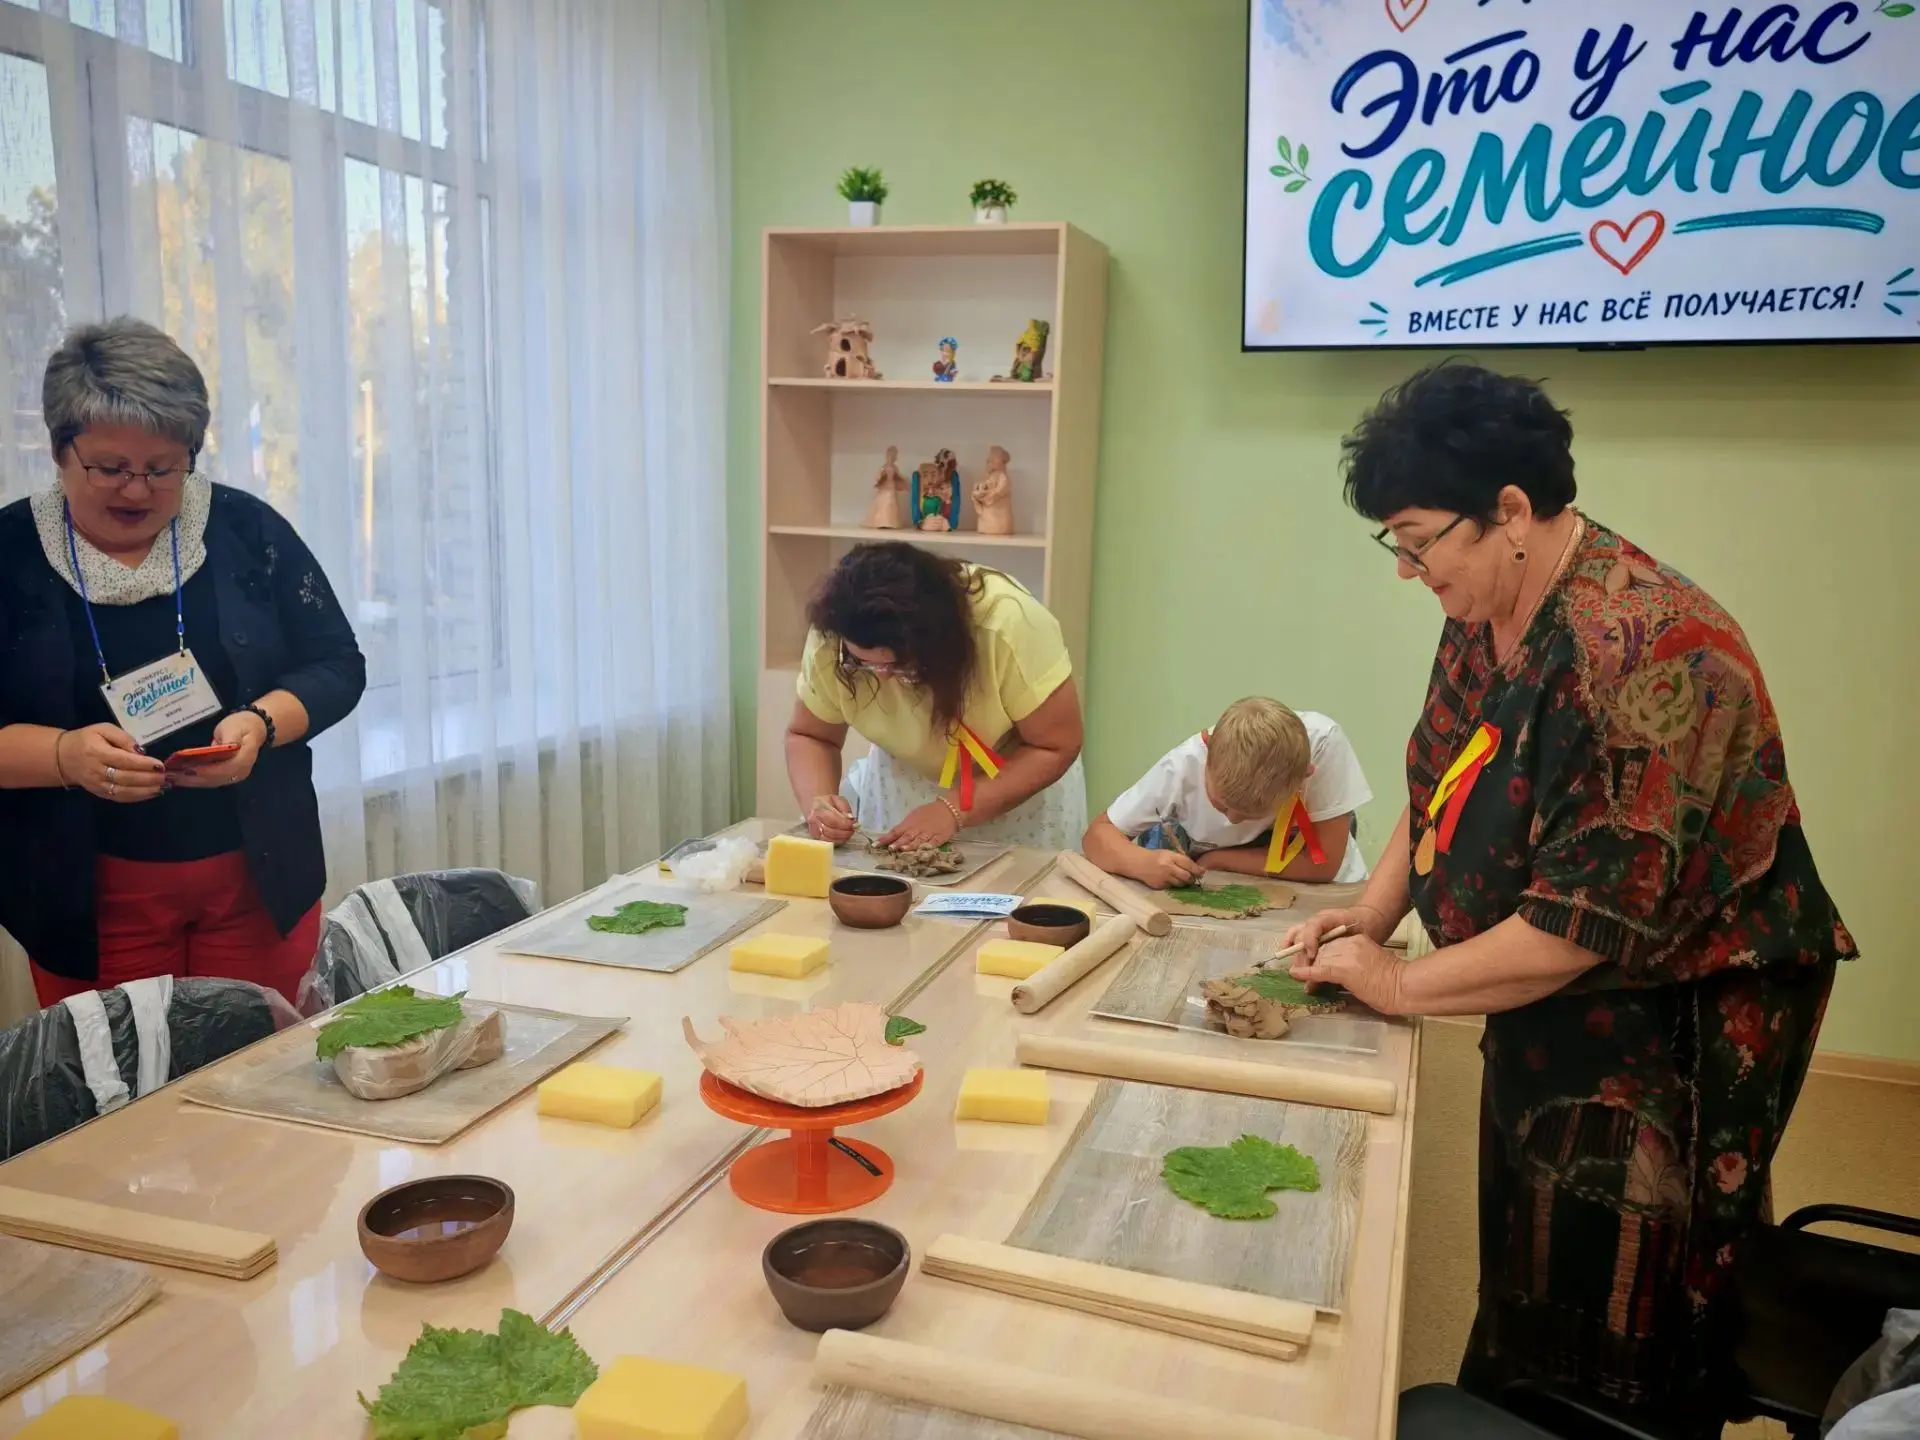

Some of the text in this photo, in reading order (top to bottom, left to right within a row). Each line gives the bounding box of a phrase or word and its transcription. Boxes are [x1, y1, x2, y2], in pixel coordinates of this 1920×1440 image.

[1331, 1, 1871, 158] Это у нас
[1408, 281, 1864, 333] ВМЕСТЕ У НАС ВСЁ ПОЛУЧАЕТСЯ!
